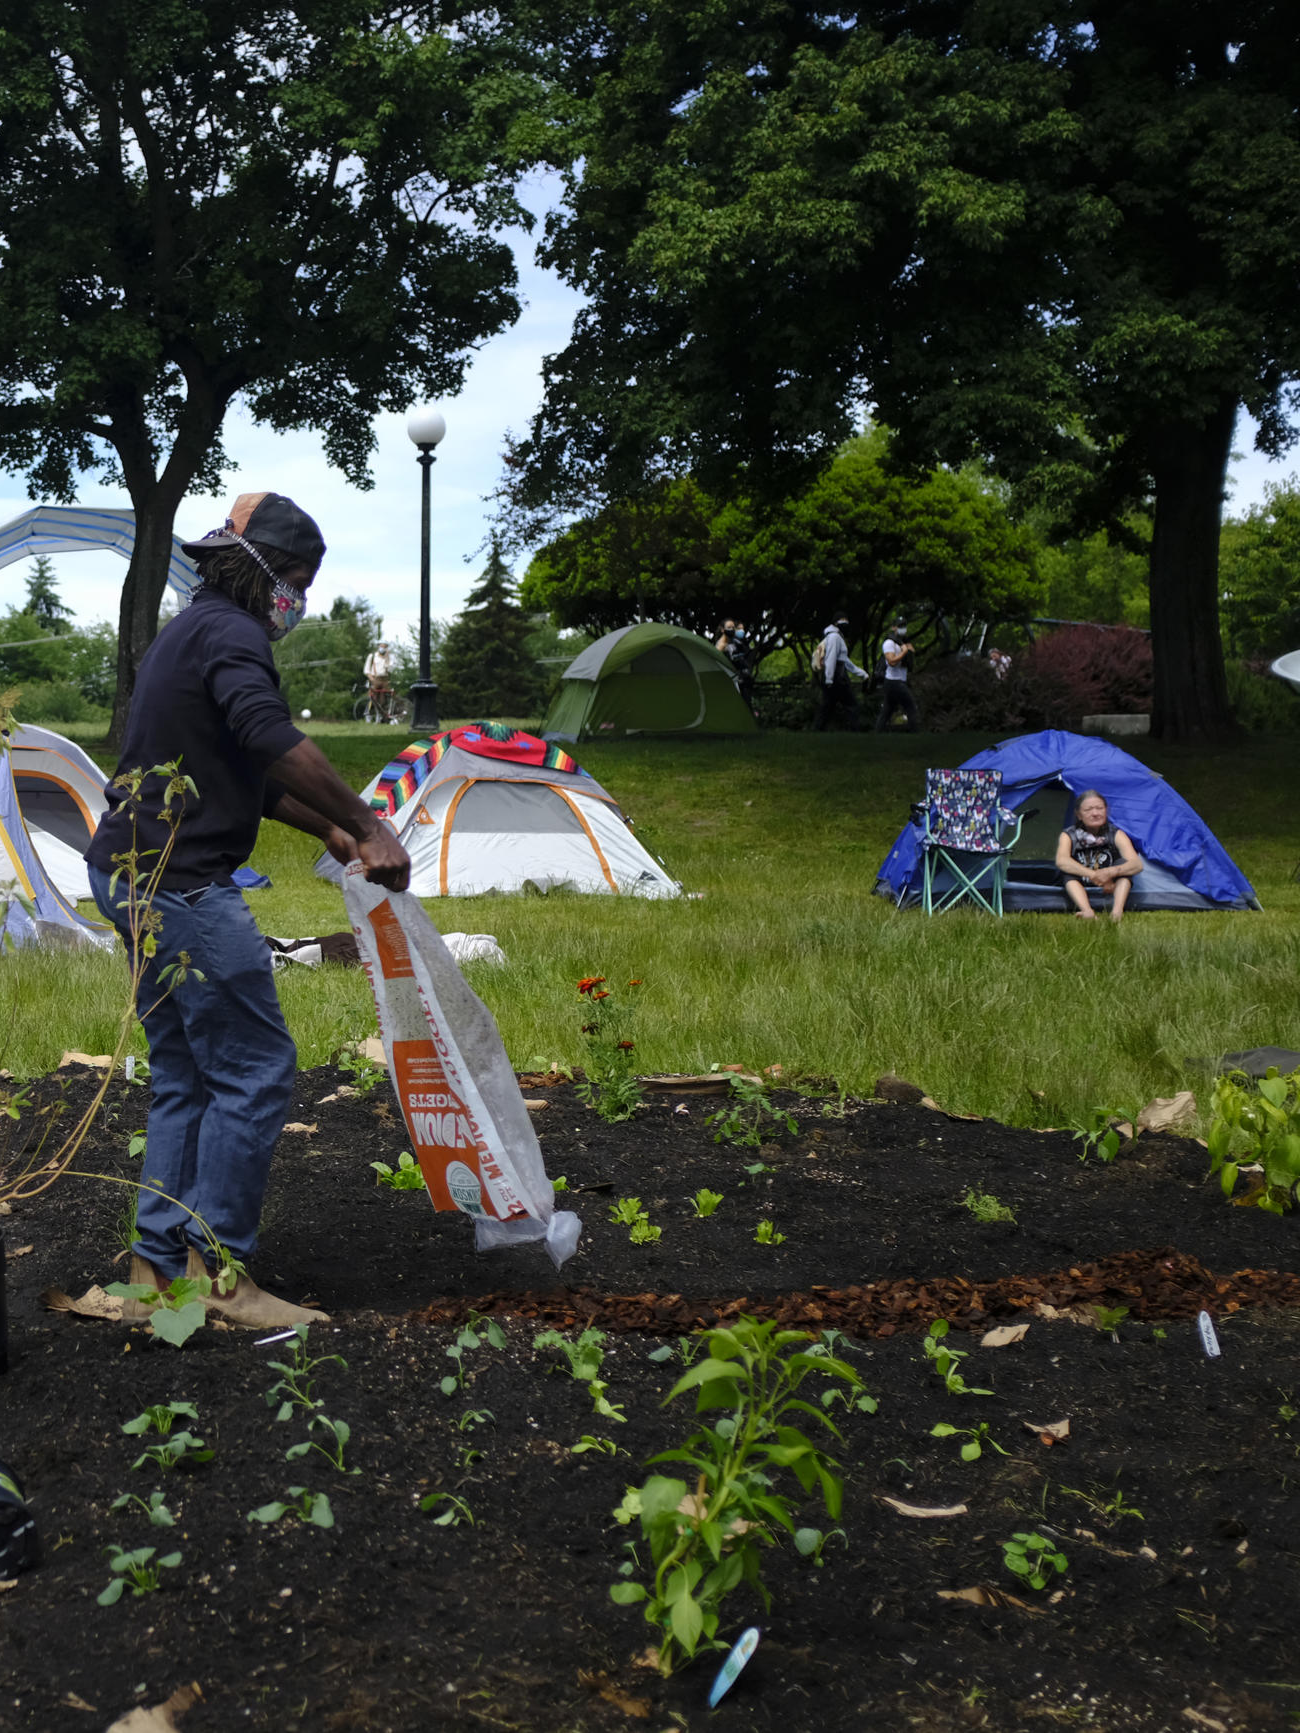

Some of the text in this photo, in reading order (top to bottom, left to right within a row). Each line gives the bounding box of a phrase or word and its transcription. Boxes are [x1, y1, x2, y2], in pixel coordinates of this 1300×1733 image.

[408, 1093, 461, 1109] GETS
[466, 1104, 504, 1181] MEDIU
[452, 1187, 481, 1202] NSON
